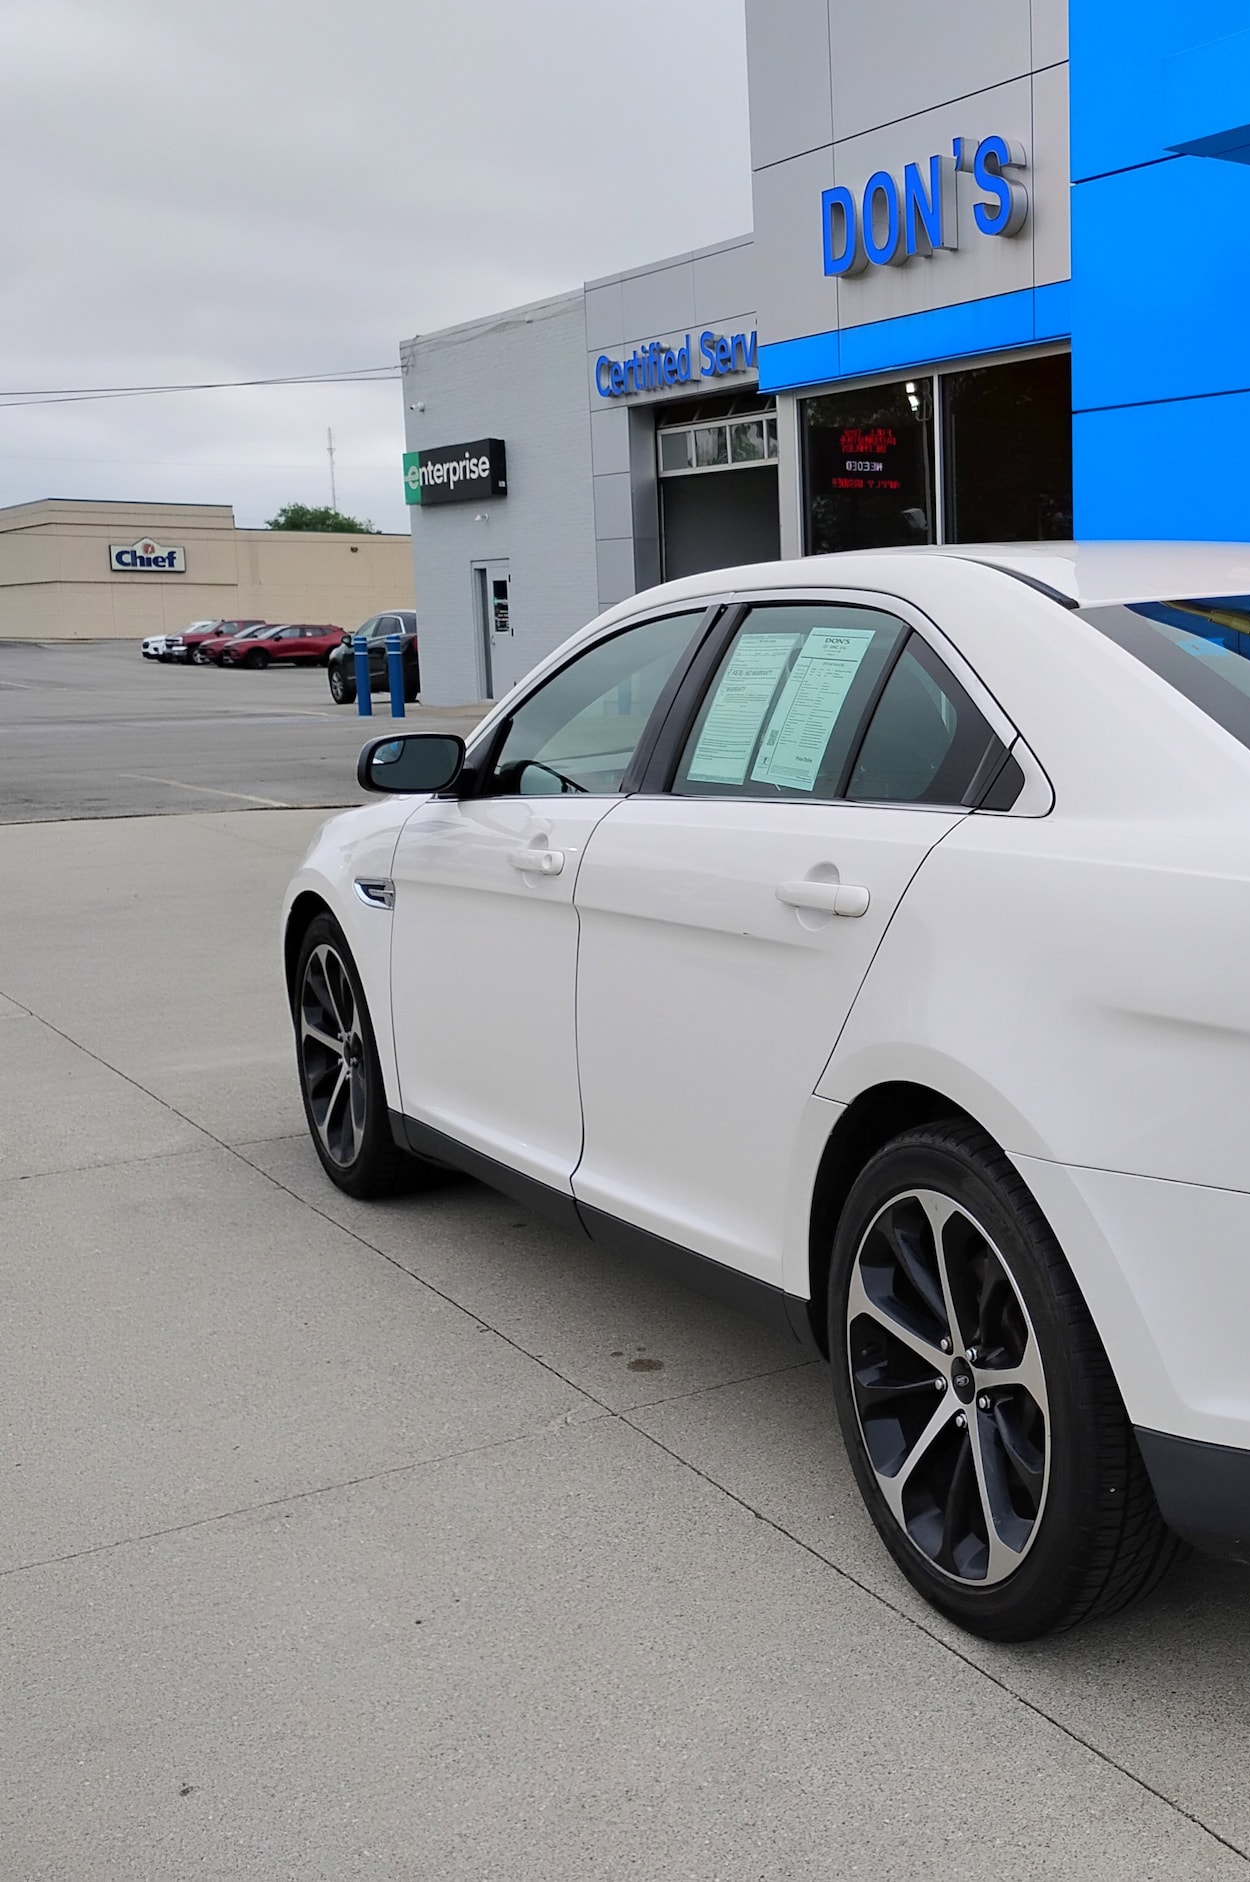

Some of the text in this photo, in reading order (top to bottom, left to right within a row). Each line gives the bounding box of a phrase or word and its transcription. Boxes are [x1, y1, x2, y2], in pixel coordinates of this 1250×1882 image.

[821, 135, 1022, 277] DON'S
[595, 333, 692, 398] Certified
[405, 451, 491, 490] enterprise
[115, 549, 177, 568] Chief
